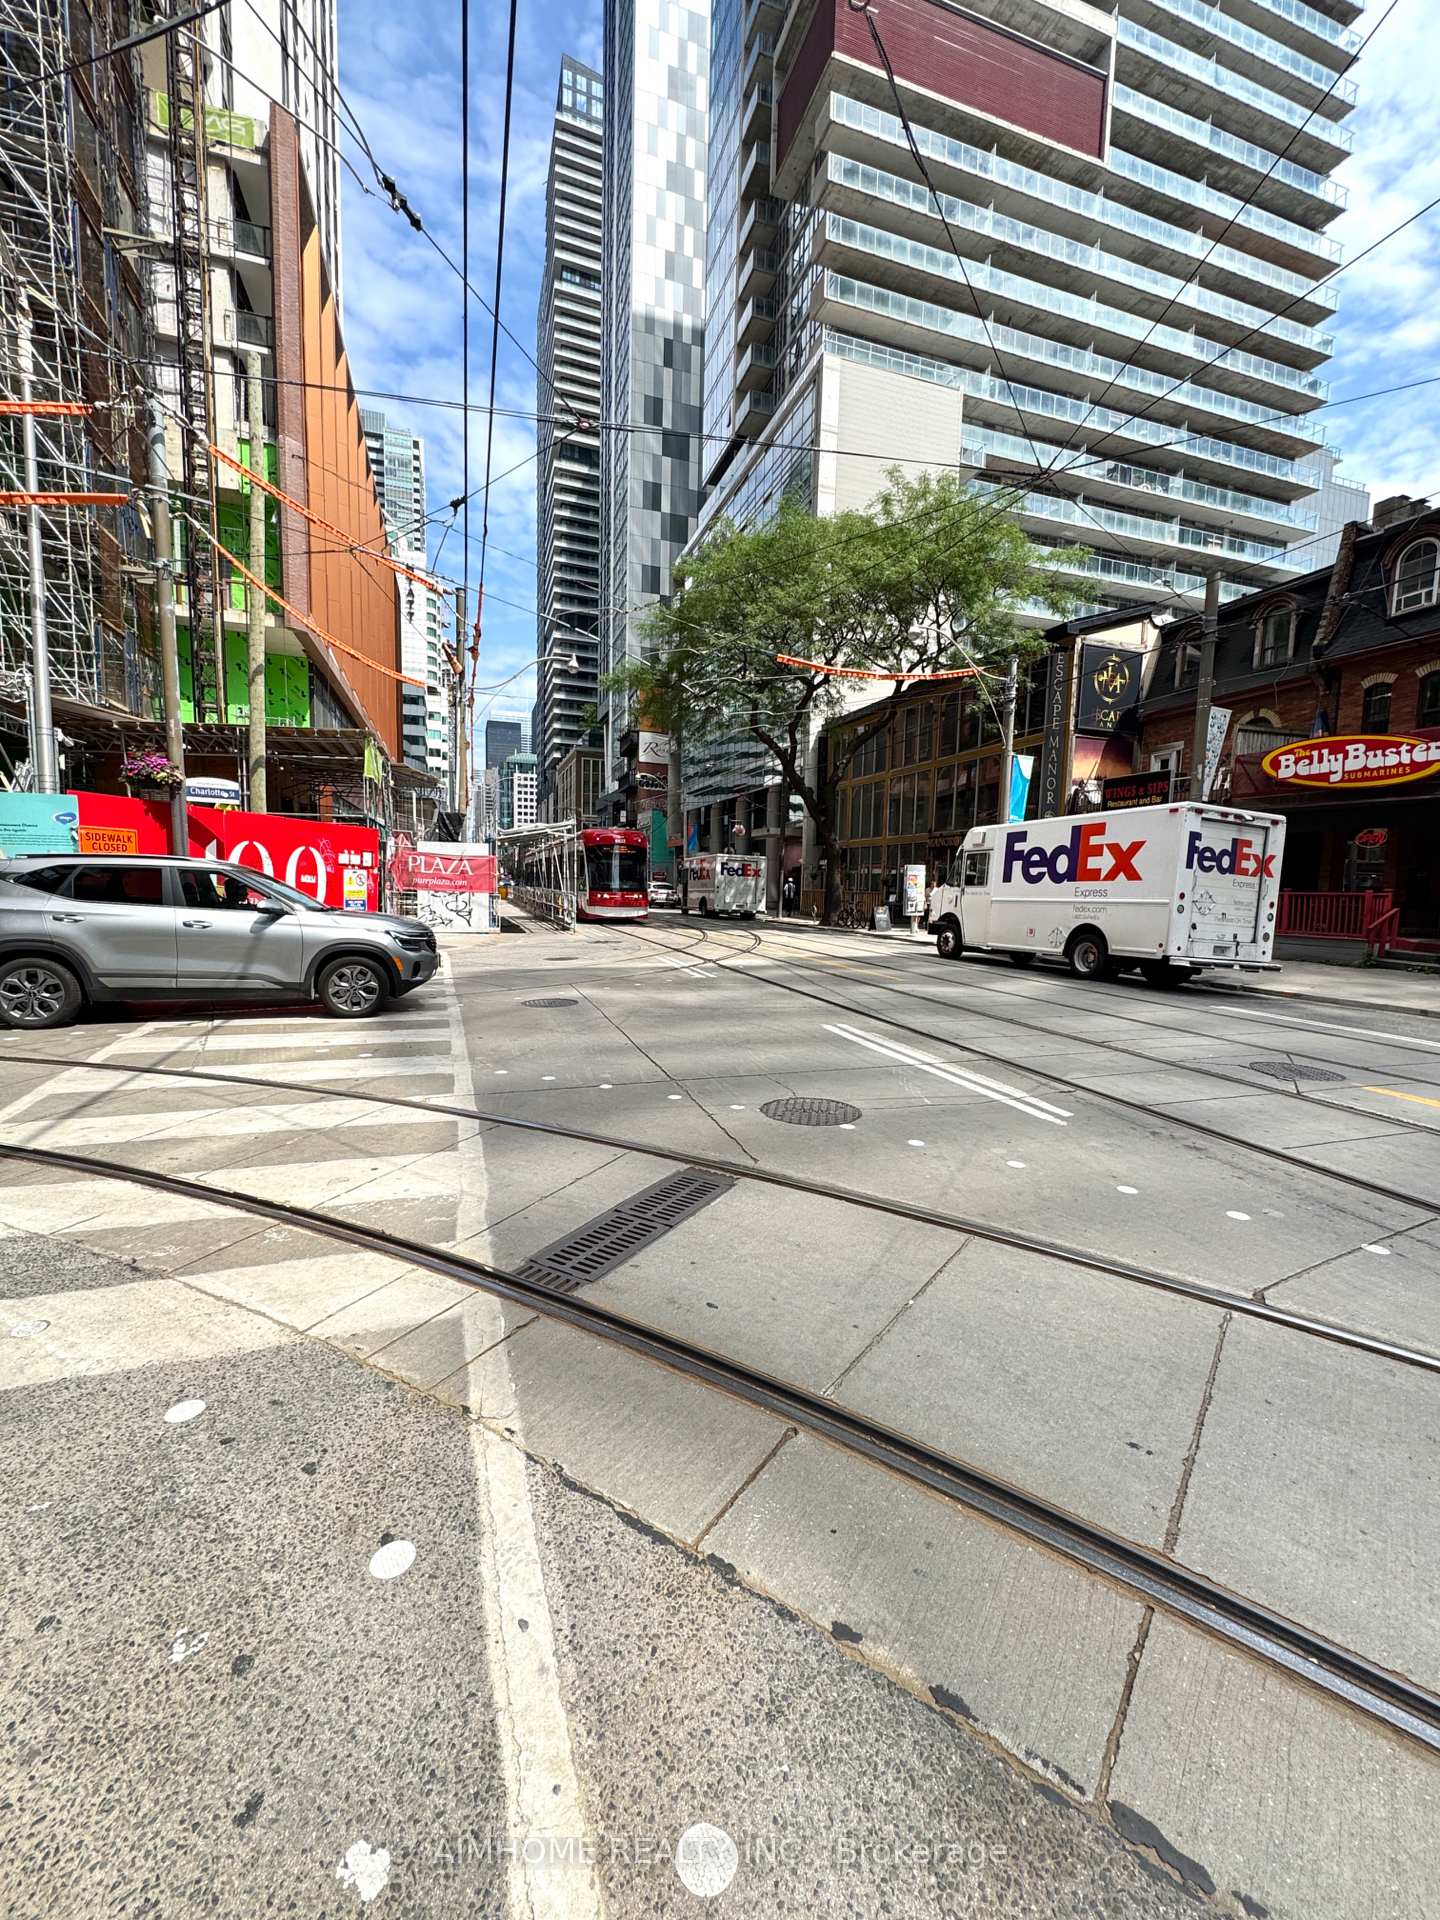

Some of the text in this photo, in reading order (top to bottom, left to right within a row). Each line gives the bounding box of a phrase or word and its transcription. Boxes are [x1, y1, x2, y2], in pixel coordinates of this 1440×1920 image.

[1052, 652, 1065, 730] ESCAPE
[1046, 735, 1060, 804] MANOR
[1278, 749, 1343, 782] Belly
[1344, 766, 1411, 780] SUBMARINES
[190, 787, 226, 797] Charlotte
[1104, 785, 1137, 799] WINGS
[1147, 780, 1169, 794] SIPS
[1107, 795, 1163, 808] Restaurant and Bar
[85, 831, 134, 844] SIDEWALK
[91, 842, 128, 853] CLOSED
[1002, 822, 1147, 884] FedEx
[1185, 830, 1276, 878] FedEx
[408, 855, 474, 876] PLAZA
[721, 861, 761, 877] FedEx
[1074, 887, 1108, 898] Express
